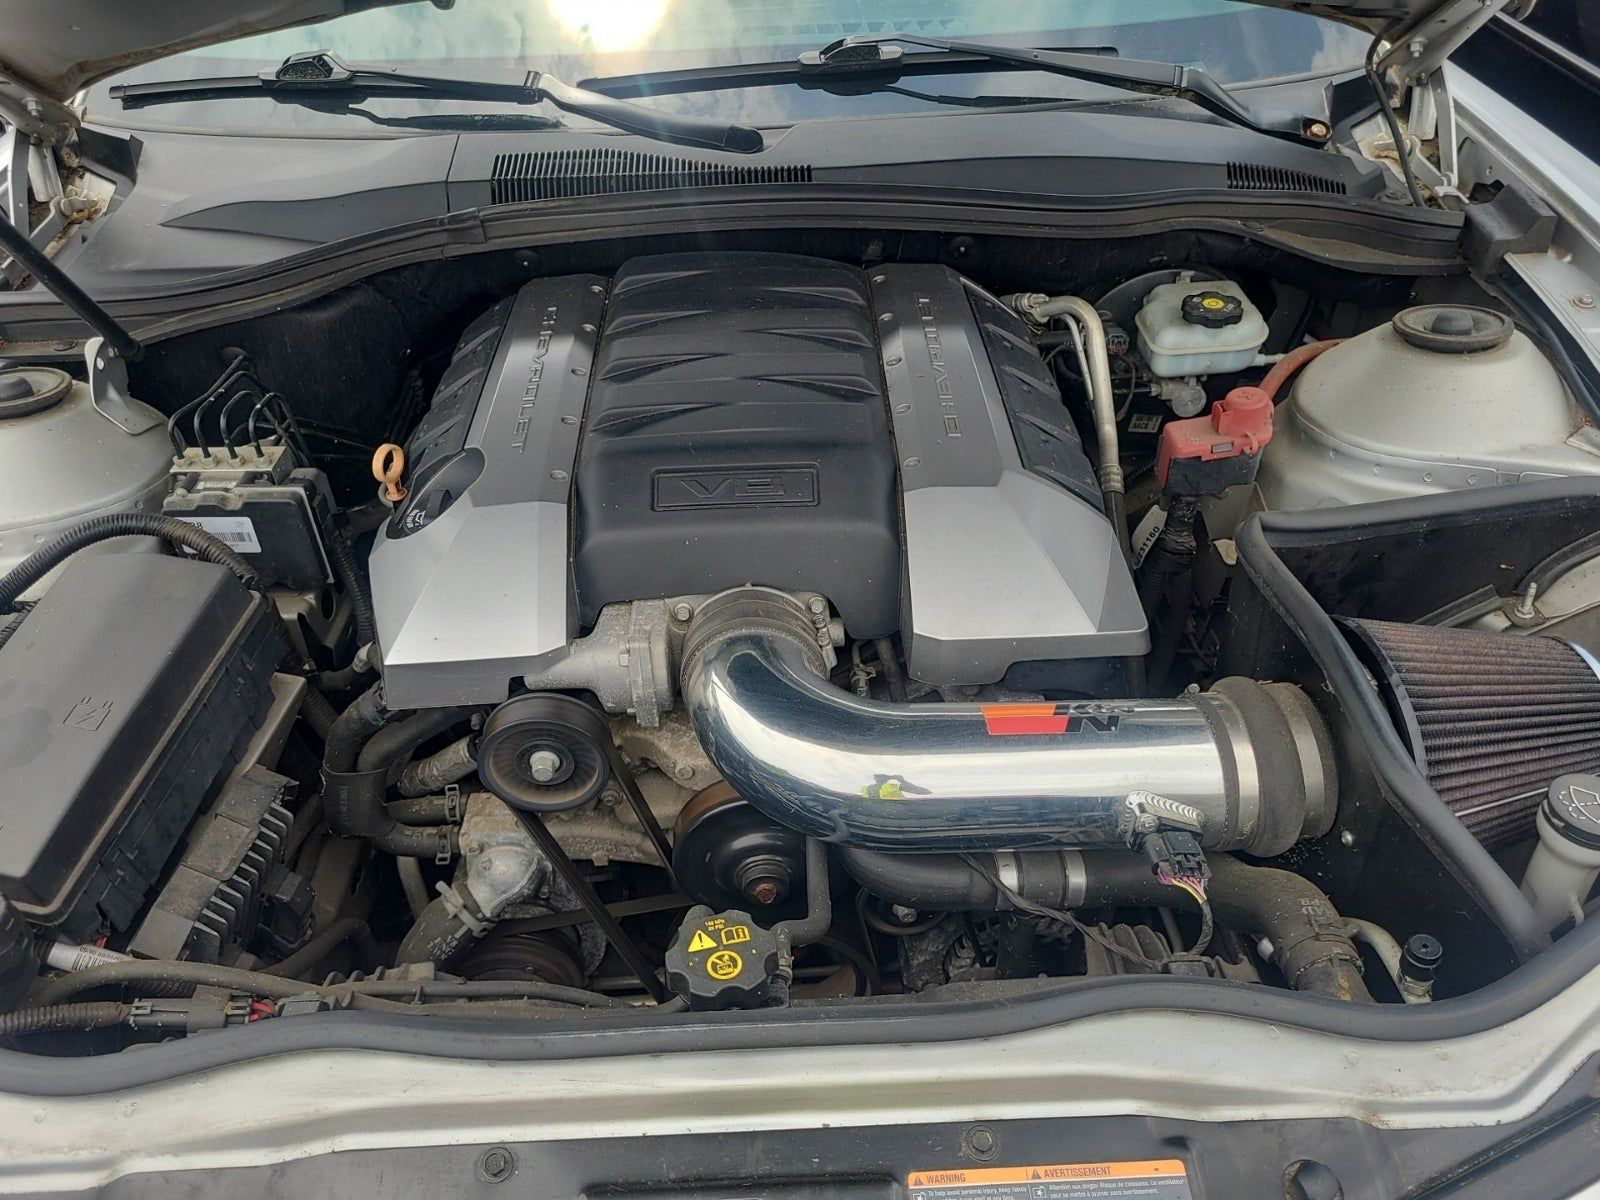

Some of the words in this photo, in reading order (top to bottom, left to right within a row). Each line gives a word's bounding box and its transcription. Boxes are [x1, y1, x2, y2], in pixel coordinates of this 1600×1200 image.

[919, 295, 962, 437] CHEVROLET
[511, 307, 557, 454] CHEVROLET
[679, 477, 786, 498] V8
[926, 1173, 966, 1184] WARNING
[1044, 1166, 1112, 1179] AVERTISSEMENT
